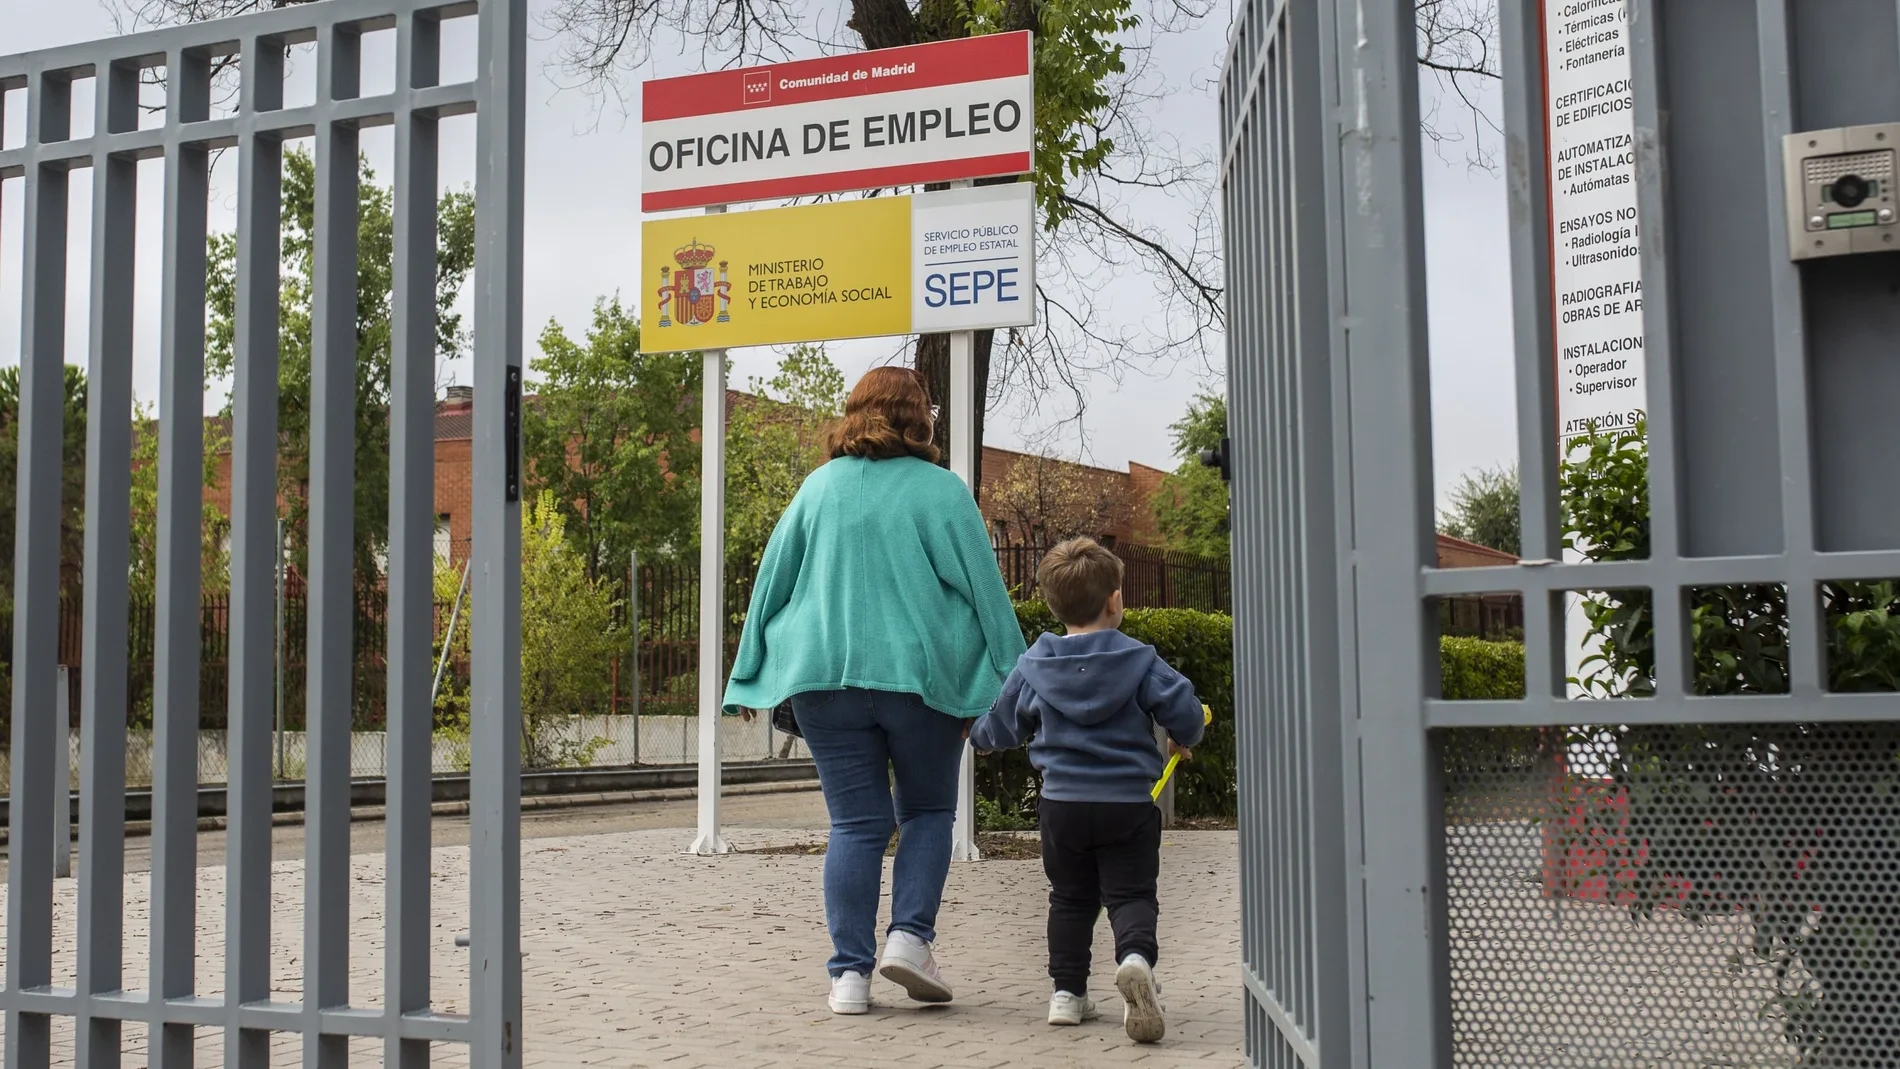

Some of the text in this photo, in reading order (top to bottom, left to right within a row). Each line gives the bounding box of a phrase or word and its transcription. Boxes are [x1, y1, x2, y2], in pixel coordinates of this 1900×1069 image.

[1564, 12, 1614, 35] Térmicas
[1565, 29, 1619, 53] Eléctricas
[1566, 45, 1625, 71] Fontanería
[779, 62, 916, 90] Comunidad de Madrid
[1556, 97, 1632, 127] DE EDIFICIOS
[649, 99, 1021, 172] OFICINA DE EMPLEO
[1557, 134, 1632, 163] AUTOMATIZA
[1558, 166, 1572, 181] DE
[1569, 173, 1630, 196] Autómatas
[1560, 207, 1636, 234] ENSAYOS NO
[924, 224, 1018, 242] SERVICIO PÚBLICO
[1571, 227, 1631, 249] Radiología
[924, 239, 1018, 255] DE EMPLEO ESTATAL
[748, 258, 824, 276] MINISTERIO
[748, 280, 766, 293] DE
[768, 274, 829, 292] TRABAJO
[924, 267, 1019, 308] SEPE
[748, 286, 892, 310] Y ECONOMÍA SOCIAL
[1562, 305, 1600, 323] OBRAS
[1604, 302, 1620, 316] DE
[1563, 336, 1643, 360] INSTALACION
[1575, 359, 1627, 378] Operador
[1575, 377, 1637, 395] Supervisor
